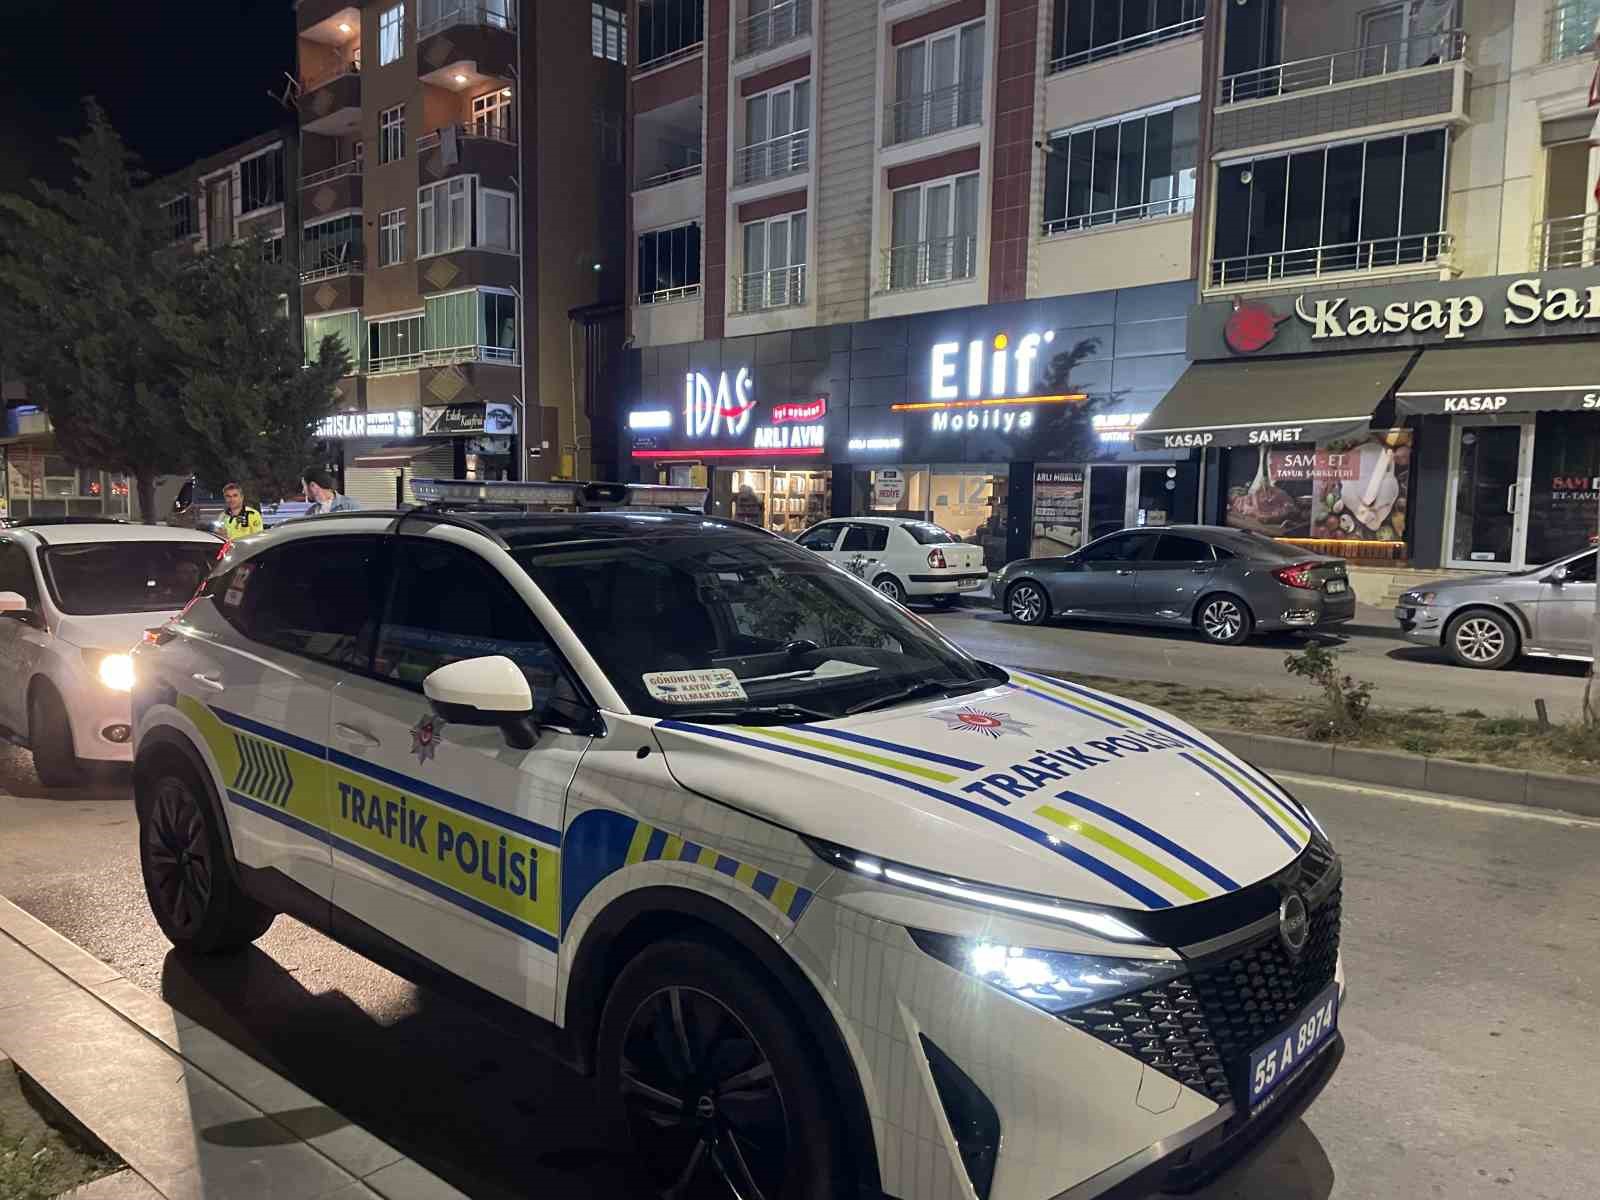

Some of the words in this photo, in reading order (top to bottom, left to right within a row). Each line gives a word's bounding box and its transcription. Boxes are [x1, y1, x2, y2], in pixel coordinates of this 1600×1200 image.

[1295, 293, 1484, 339] Kasap
[930, 335, 1041, 399] Elif
[931, 408, 1034, 434] Mobilya
[1444, 396, 1507, 411] KASAP
[790, 425, 824, 447] AVM
[1165, 433, 1213, 448] KASAP
[1249, 428, 1302, 443] SAMET
[1284, 454, 1317, 467] SAM
[1328, 454, 1345, 466] ET
[961, 745, 1110, 806] TRAFİK
[338, 781, 429, 854] TRAFİK
[437, 822, 539, 903] POLİSİ
[1254, 1050, 1277, 1094] 55
[1280, 1037, 1293, 1072] A
[1297, 1000, 1332, 1055] 8974
